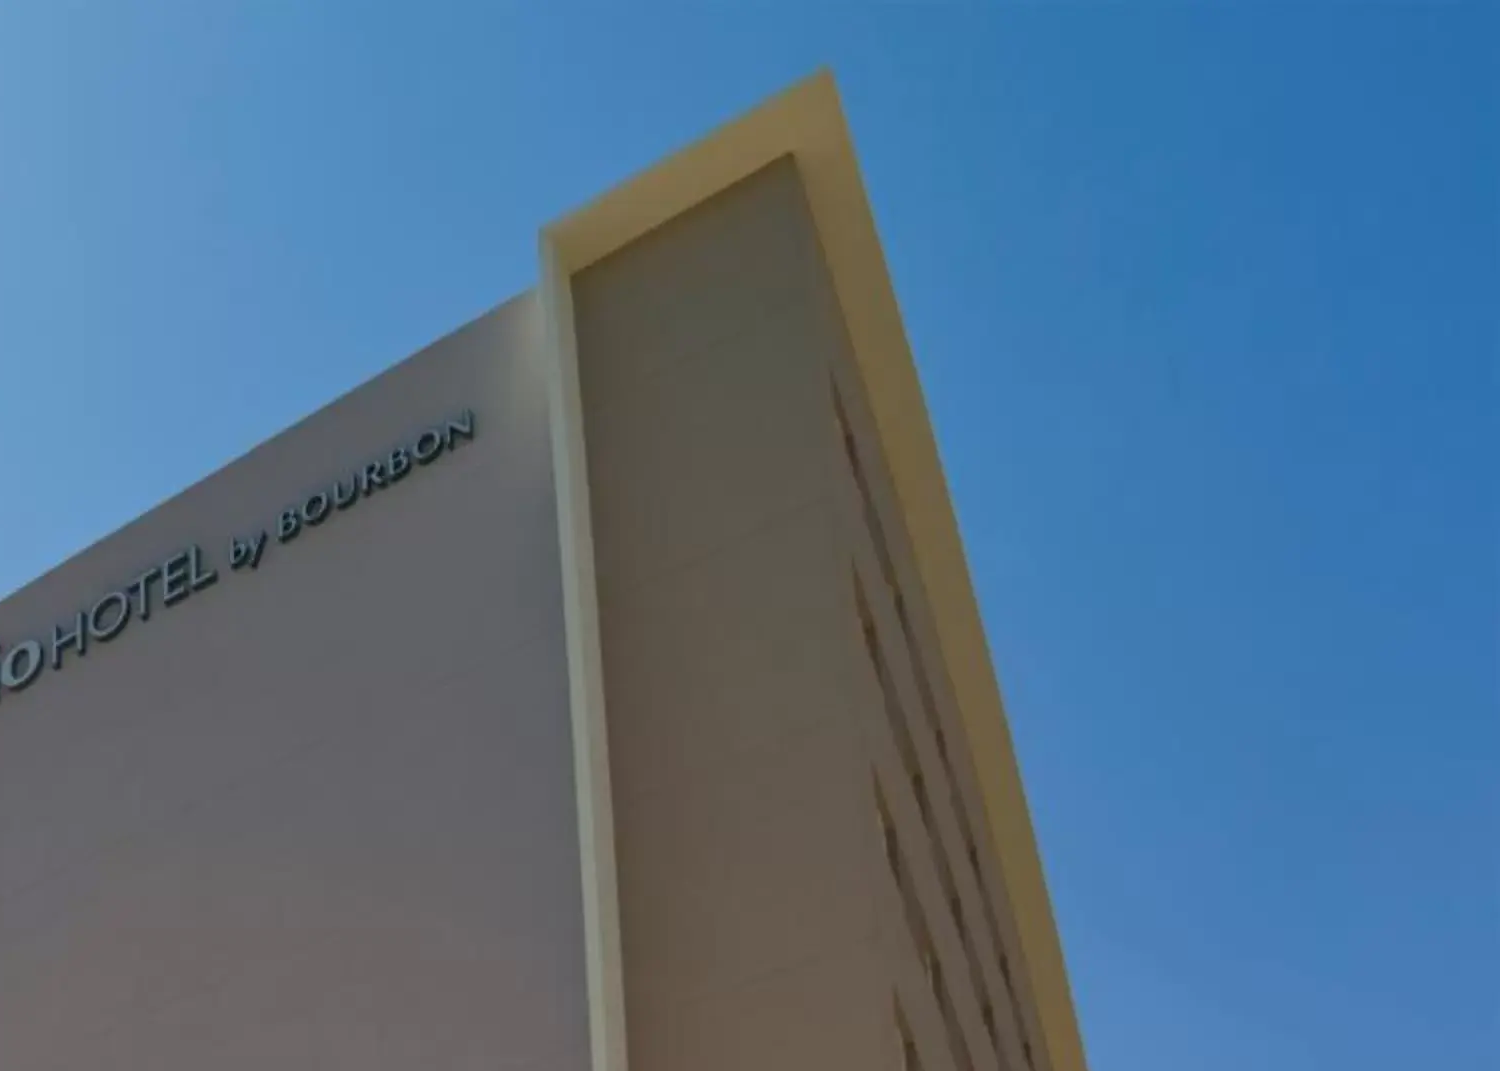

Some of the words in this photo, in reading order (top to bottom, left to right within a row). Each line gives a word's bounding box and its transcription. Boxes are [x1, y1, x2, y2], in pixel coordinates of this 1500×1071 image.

[51, 544, 218, 670] HOTEL
[227, 532, 267, 570] by
[276, 408, 476, 543] BOURBON
